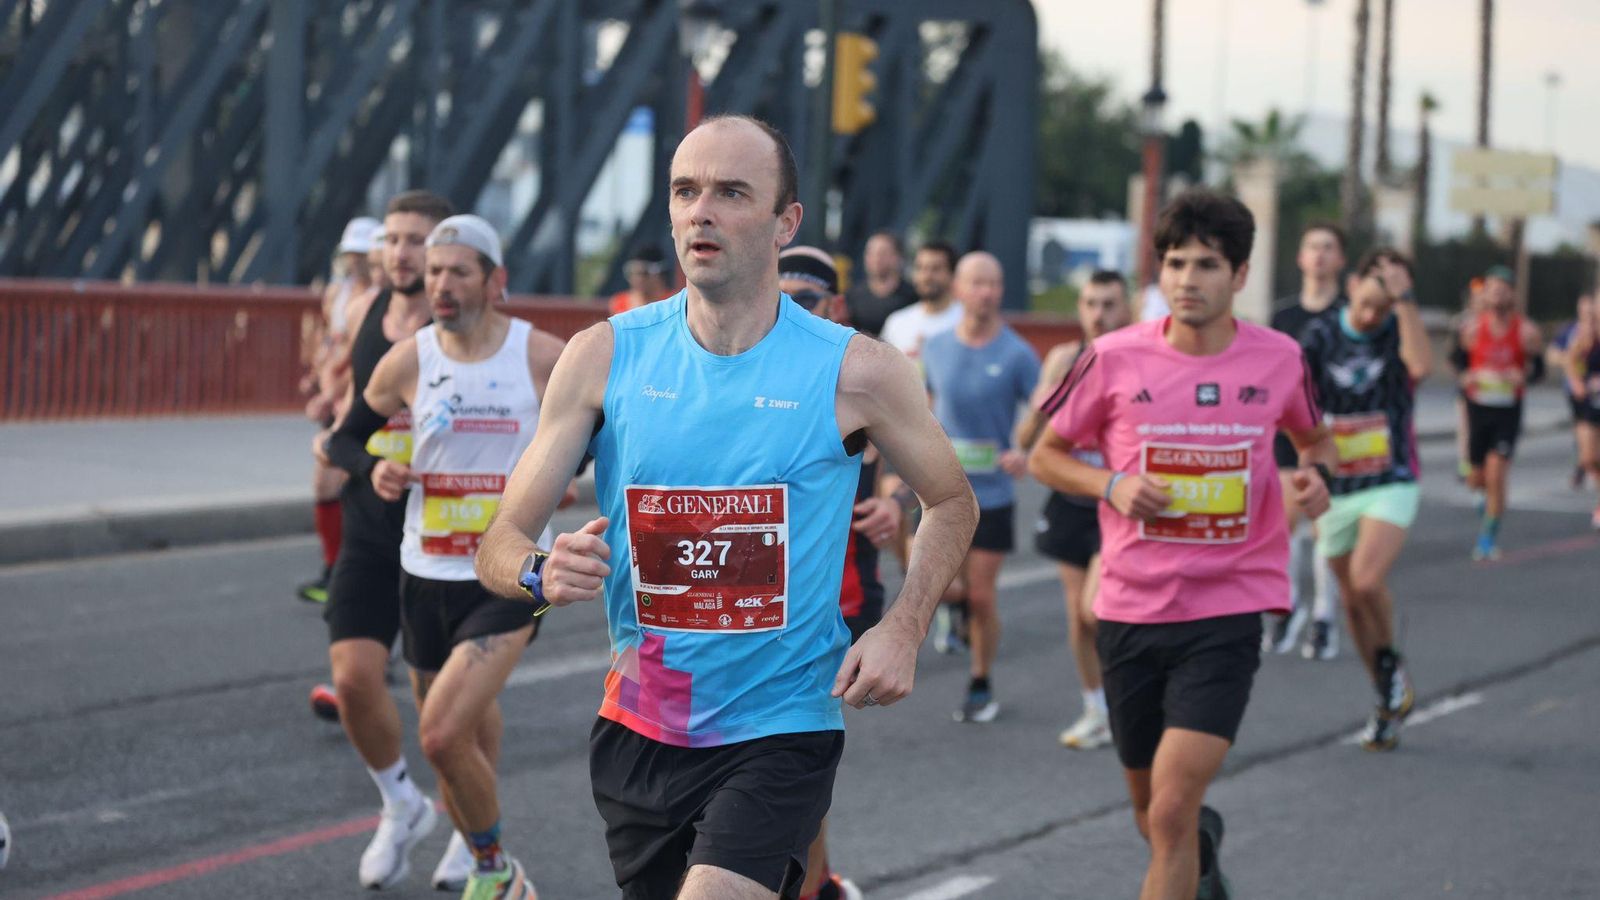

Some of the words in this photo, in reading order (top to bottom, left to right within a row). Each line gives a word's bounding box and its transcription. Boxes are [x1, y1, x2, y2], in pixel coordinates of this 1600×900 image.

[768, 399, 799, 409] ZWIFT
[666, 494, 773, 515] GENERALI
[677, 540, 731, 566] 327
[691, 569, 719, 579] GARY
[734, 597, 763, 608] 42K
[761, 615, 780, 623] renfe
